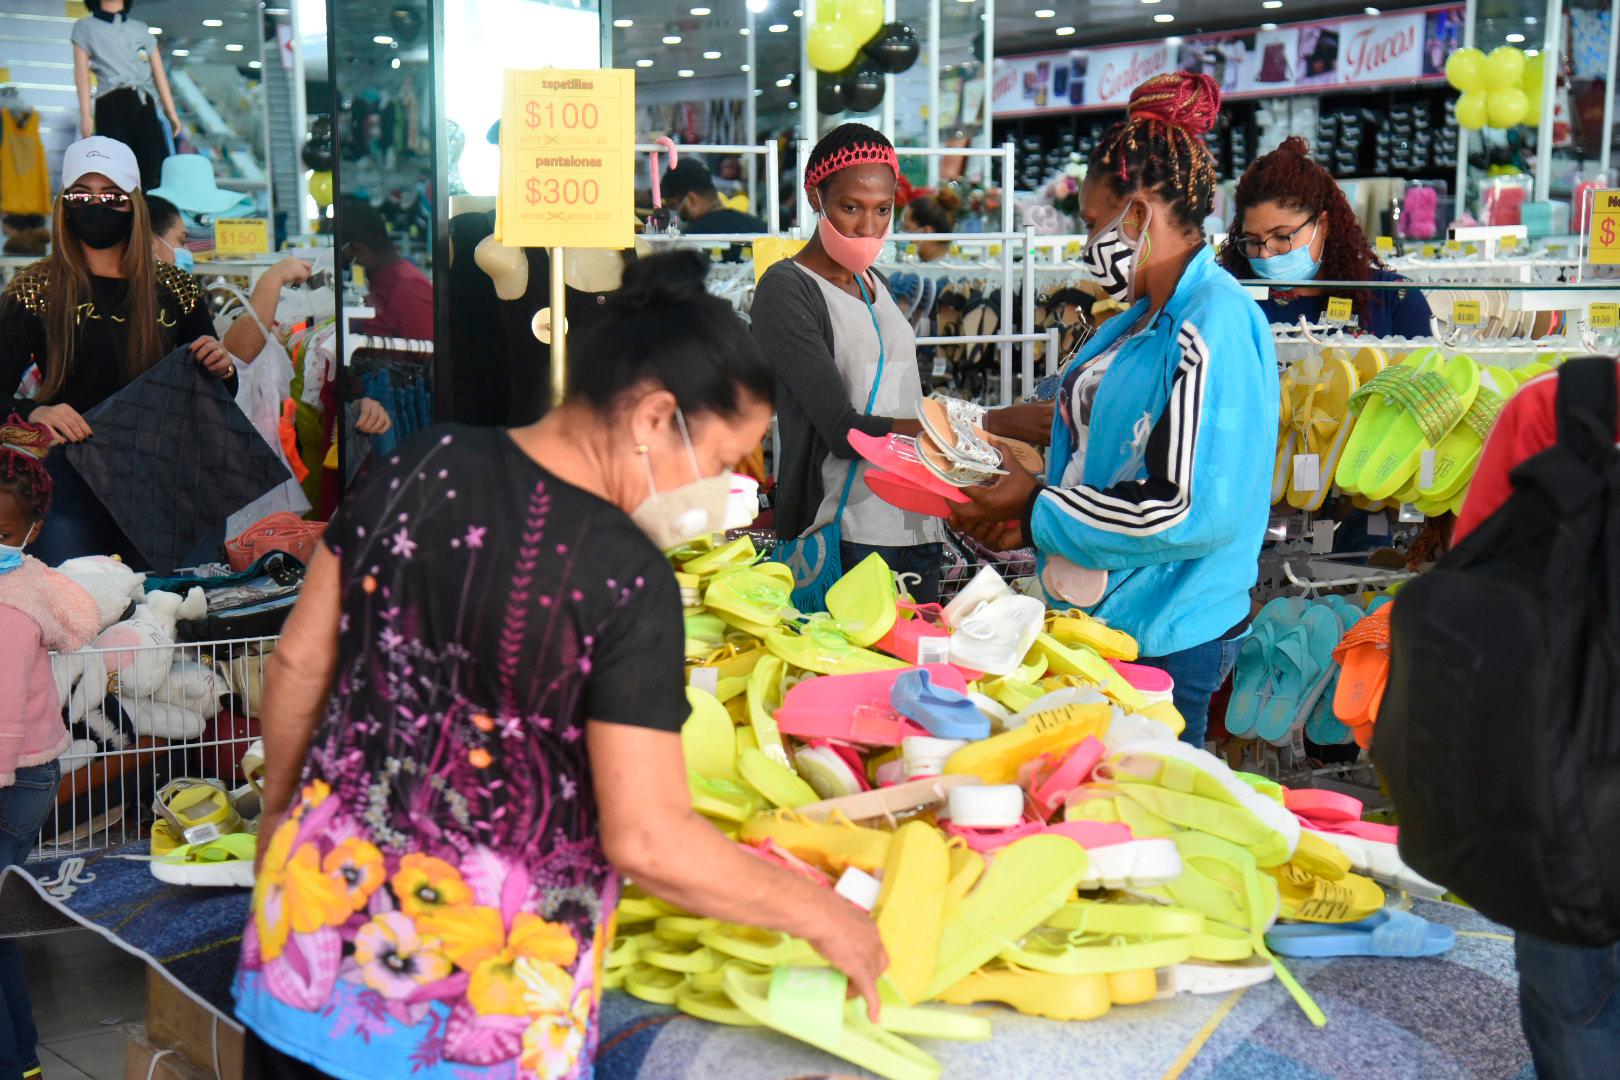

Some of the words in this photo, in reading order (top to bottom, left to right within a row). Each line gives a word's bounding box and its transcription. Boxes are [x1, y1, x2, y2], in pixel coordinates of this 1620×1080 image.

[525, 100, 599, 130] $100
[536, 155, 602, 168] pantalones
[525, 176, 599, 205] $300
